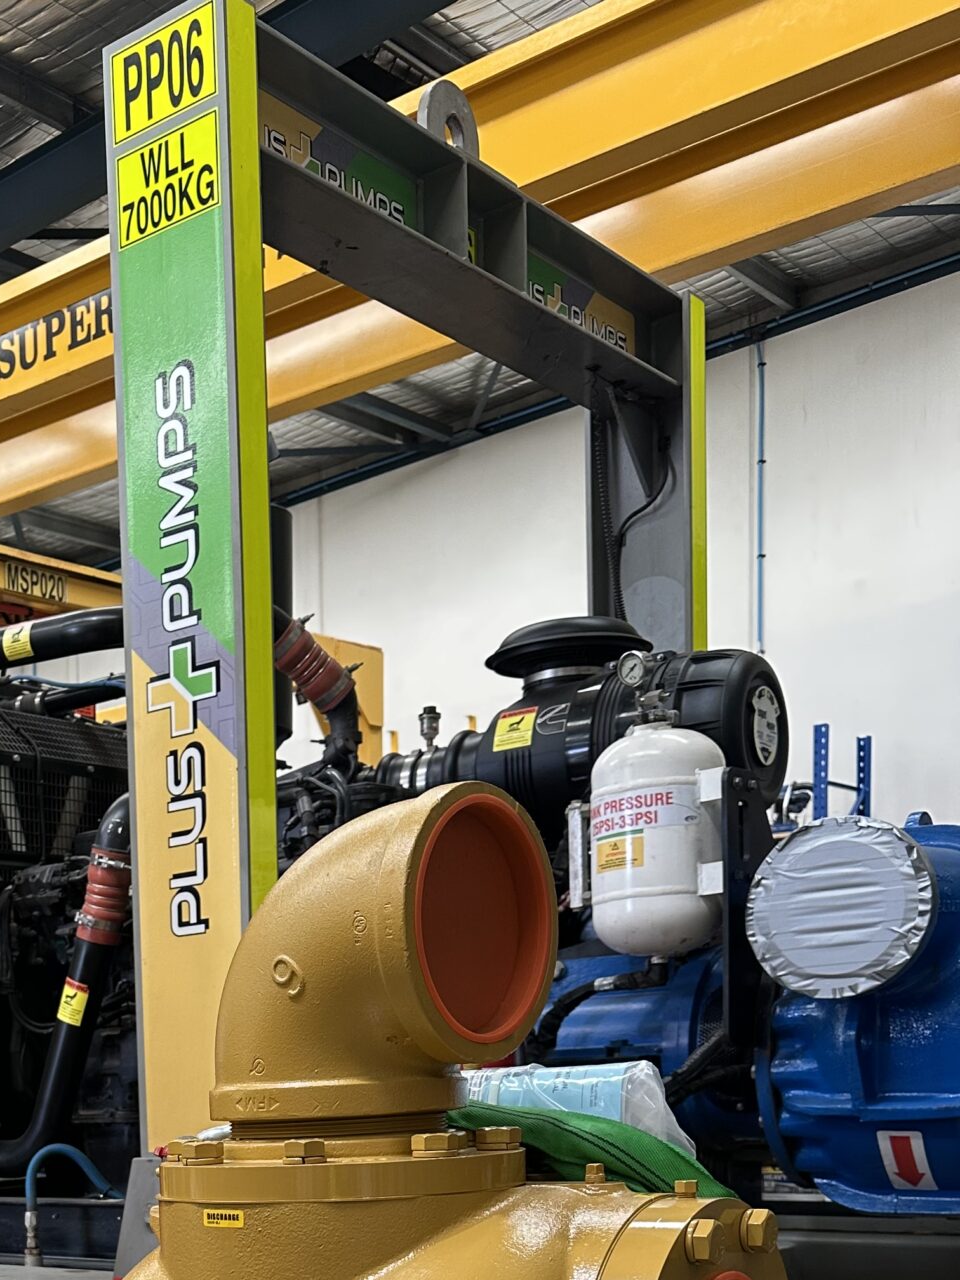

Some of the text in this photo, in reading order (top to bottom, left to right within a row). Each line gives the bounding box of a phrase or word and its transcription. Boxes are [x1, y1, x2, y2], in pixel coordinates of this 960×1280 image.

[123, 18, 204, 132] PP06
[140, 132, 195, 188] WLL
[122, 163, 215, 242] 7000KG
[7, 563, 65, 602] MSP020
[155, 359, 210, 937] PLUS PUMPS
[603, 791, 674, 817] PRESSURE
